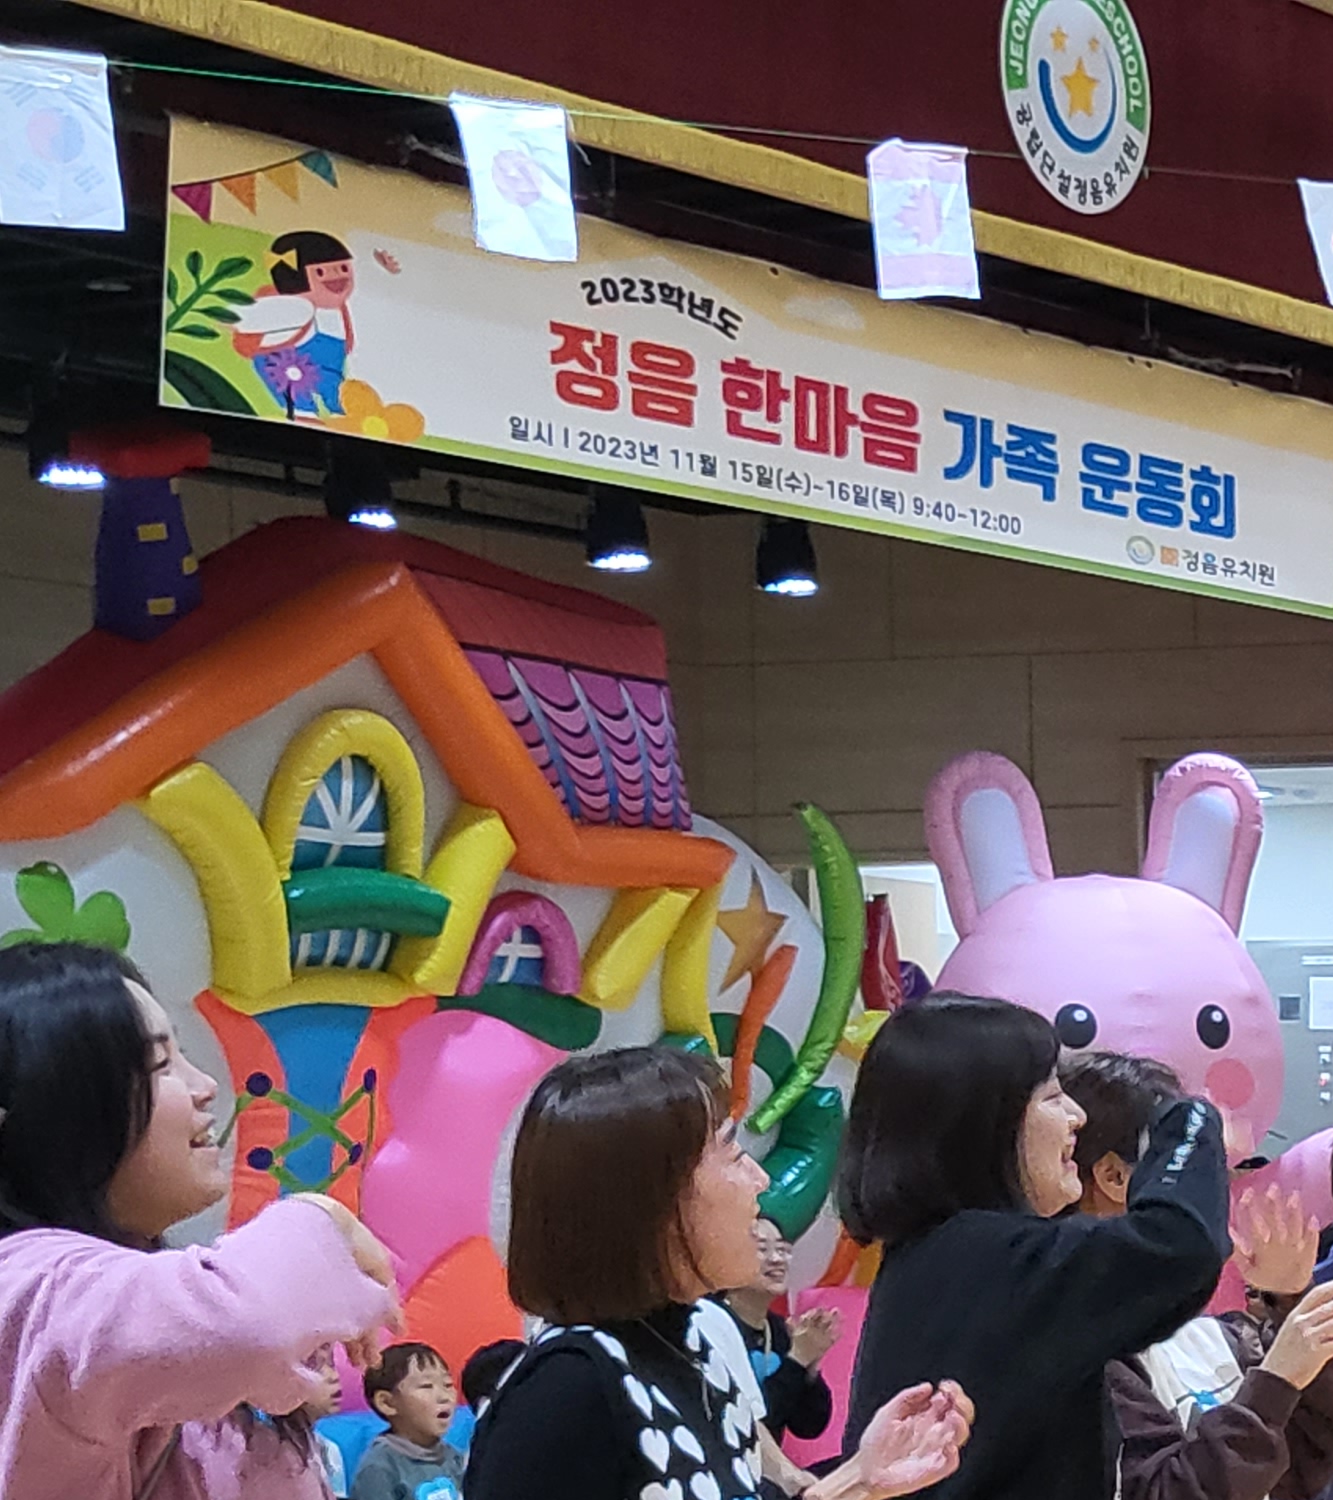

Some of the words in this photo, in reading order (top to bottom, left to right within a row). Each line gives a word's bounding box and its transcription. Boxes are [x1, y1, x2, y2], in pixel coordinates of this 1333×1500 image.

[580, 277, 744, 340] 2023학년도
[549, 320, 698, 428] 정음
[720, 356, 921, 474] 한마음
[942, 408, 1059, 502] 가족
[1078, 441, 1237, 539] 운동회
[509, 416, 553, 447] 일시
[578, 431, 659, 467] 2023년
[669, 448, 718, 479] 11월
[727, 459, 905, 515] 15일(수)~16일(목)
[912, 496, 1022, 535] 9:40-12:00
[1182, 549, 1276, 587] 정음유치원
